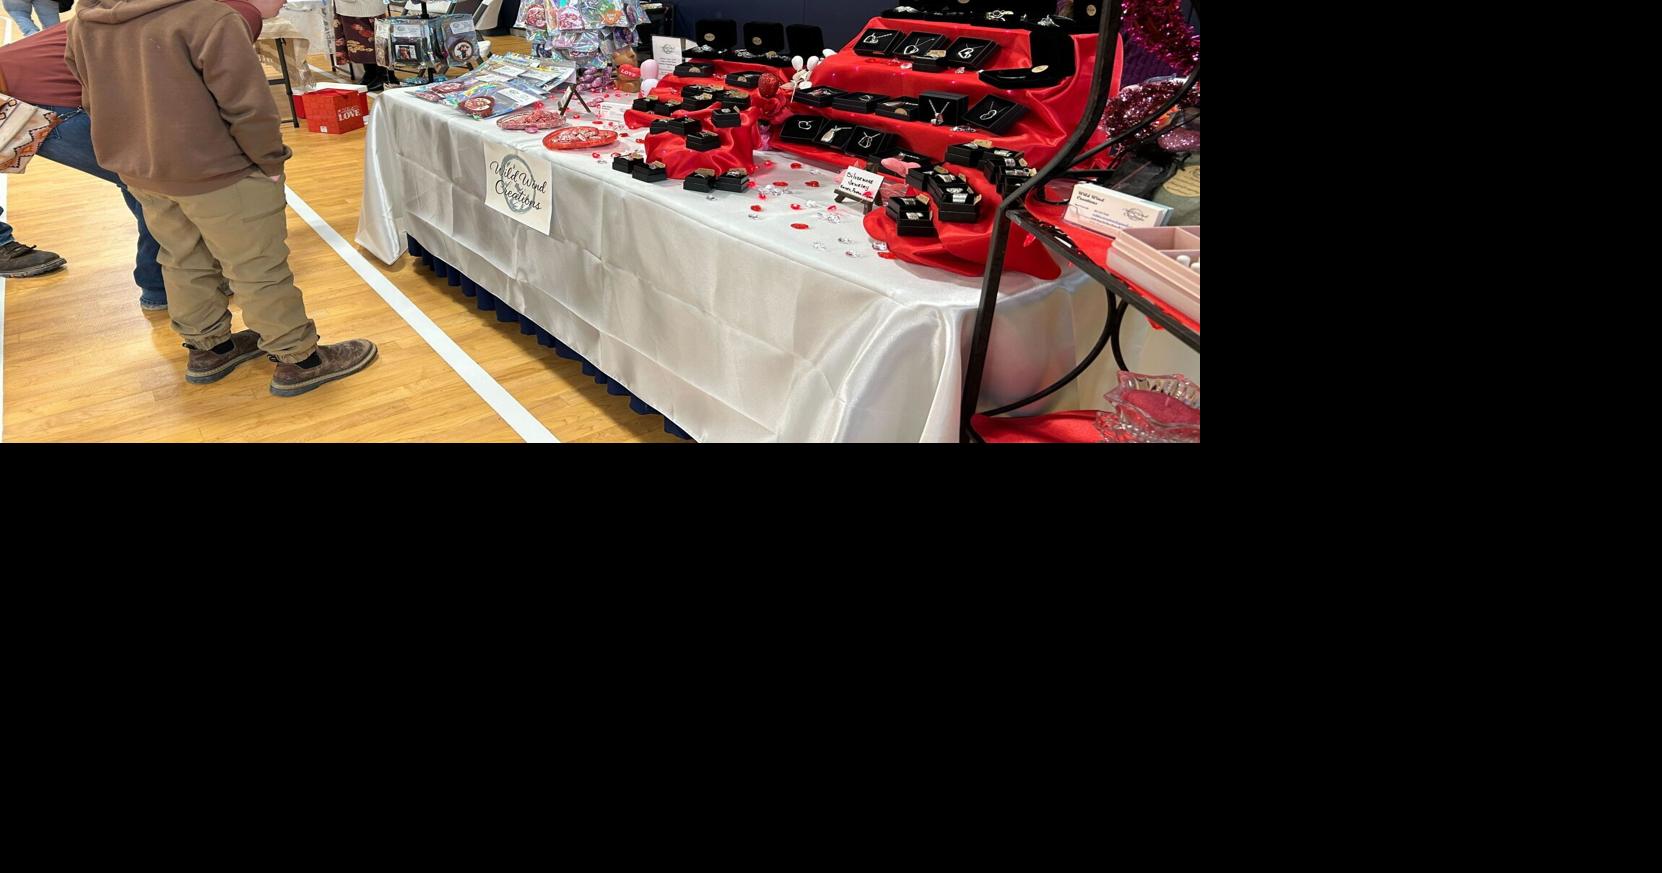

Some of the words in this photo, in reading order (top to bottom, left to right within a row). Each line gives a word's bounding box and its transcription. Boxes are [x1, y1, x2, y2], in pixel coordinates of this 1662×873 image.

[338, 109, 360, 121] LOVE
[489, 161, 520, 182] Wild
[519, 172, 547, 193] Wind
[495, 180, 541, 210] Creations
